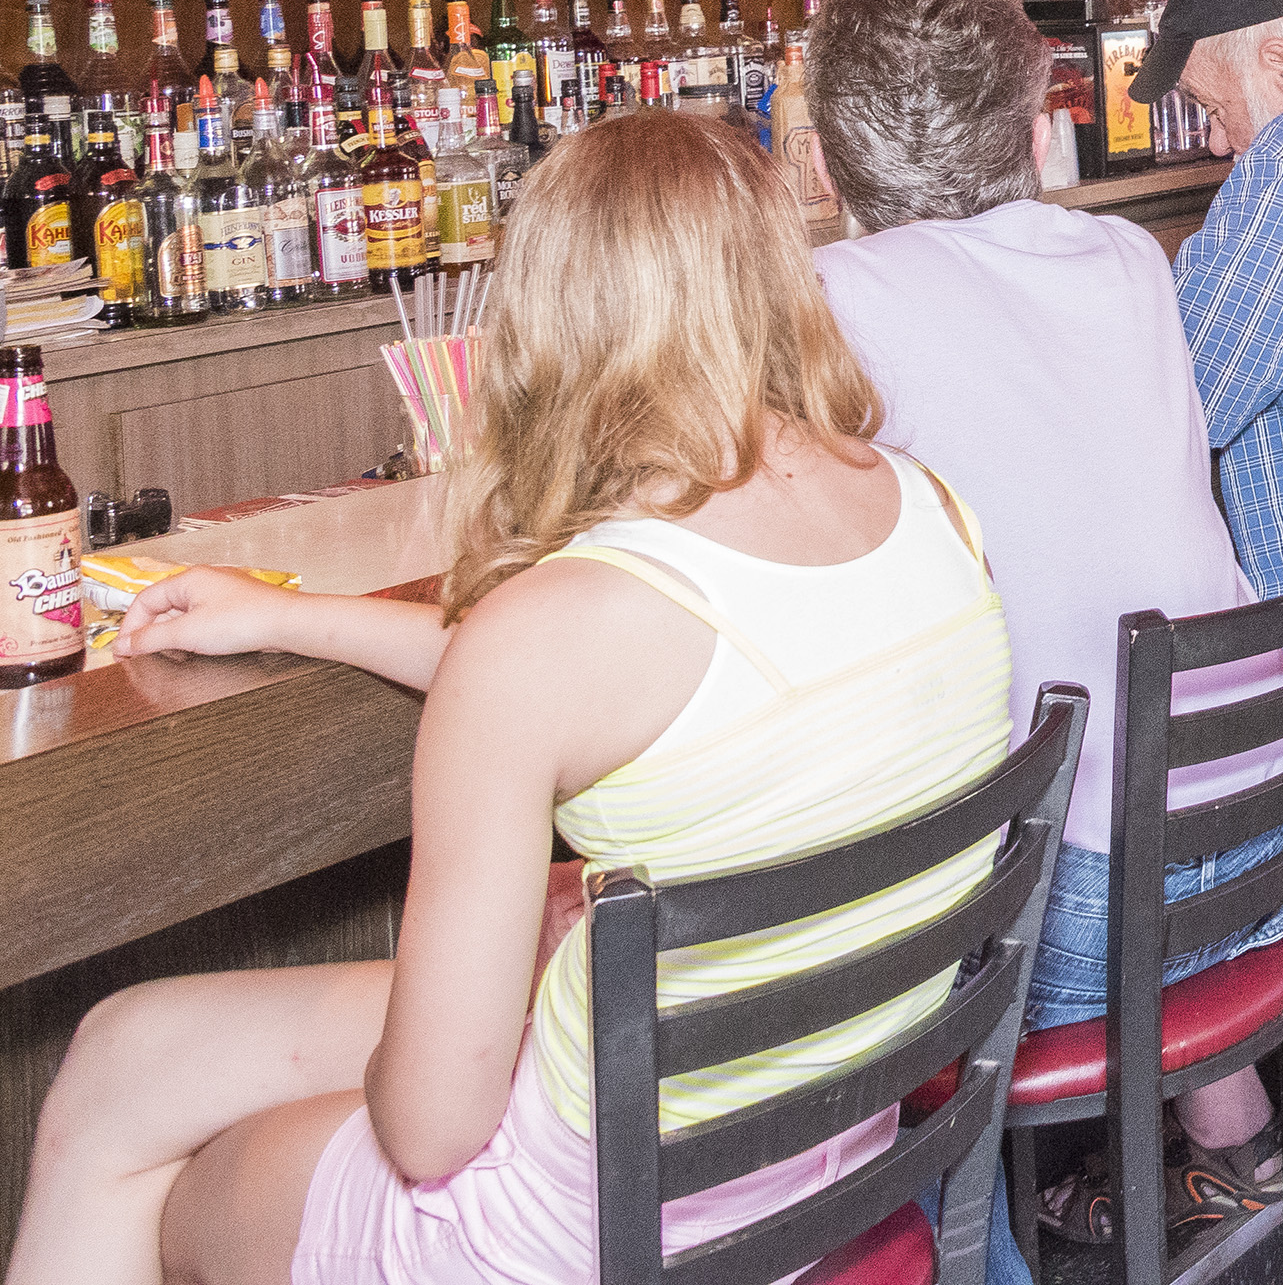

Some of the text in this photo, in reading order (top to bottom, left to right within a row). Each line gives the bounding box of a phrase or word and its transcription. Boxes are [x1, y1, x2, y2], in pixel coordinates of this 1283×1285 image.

[414, 107, 439, 119] STOLI
[462, 195, 488, 216] red
[369, 206, 419, 224] KESSLER
[231, 255, 256, 267] GIN
[7, 529, 63, 544] Old Fashioned
